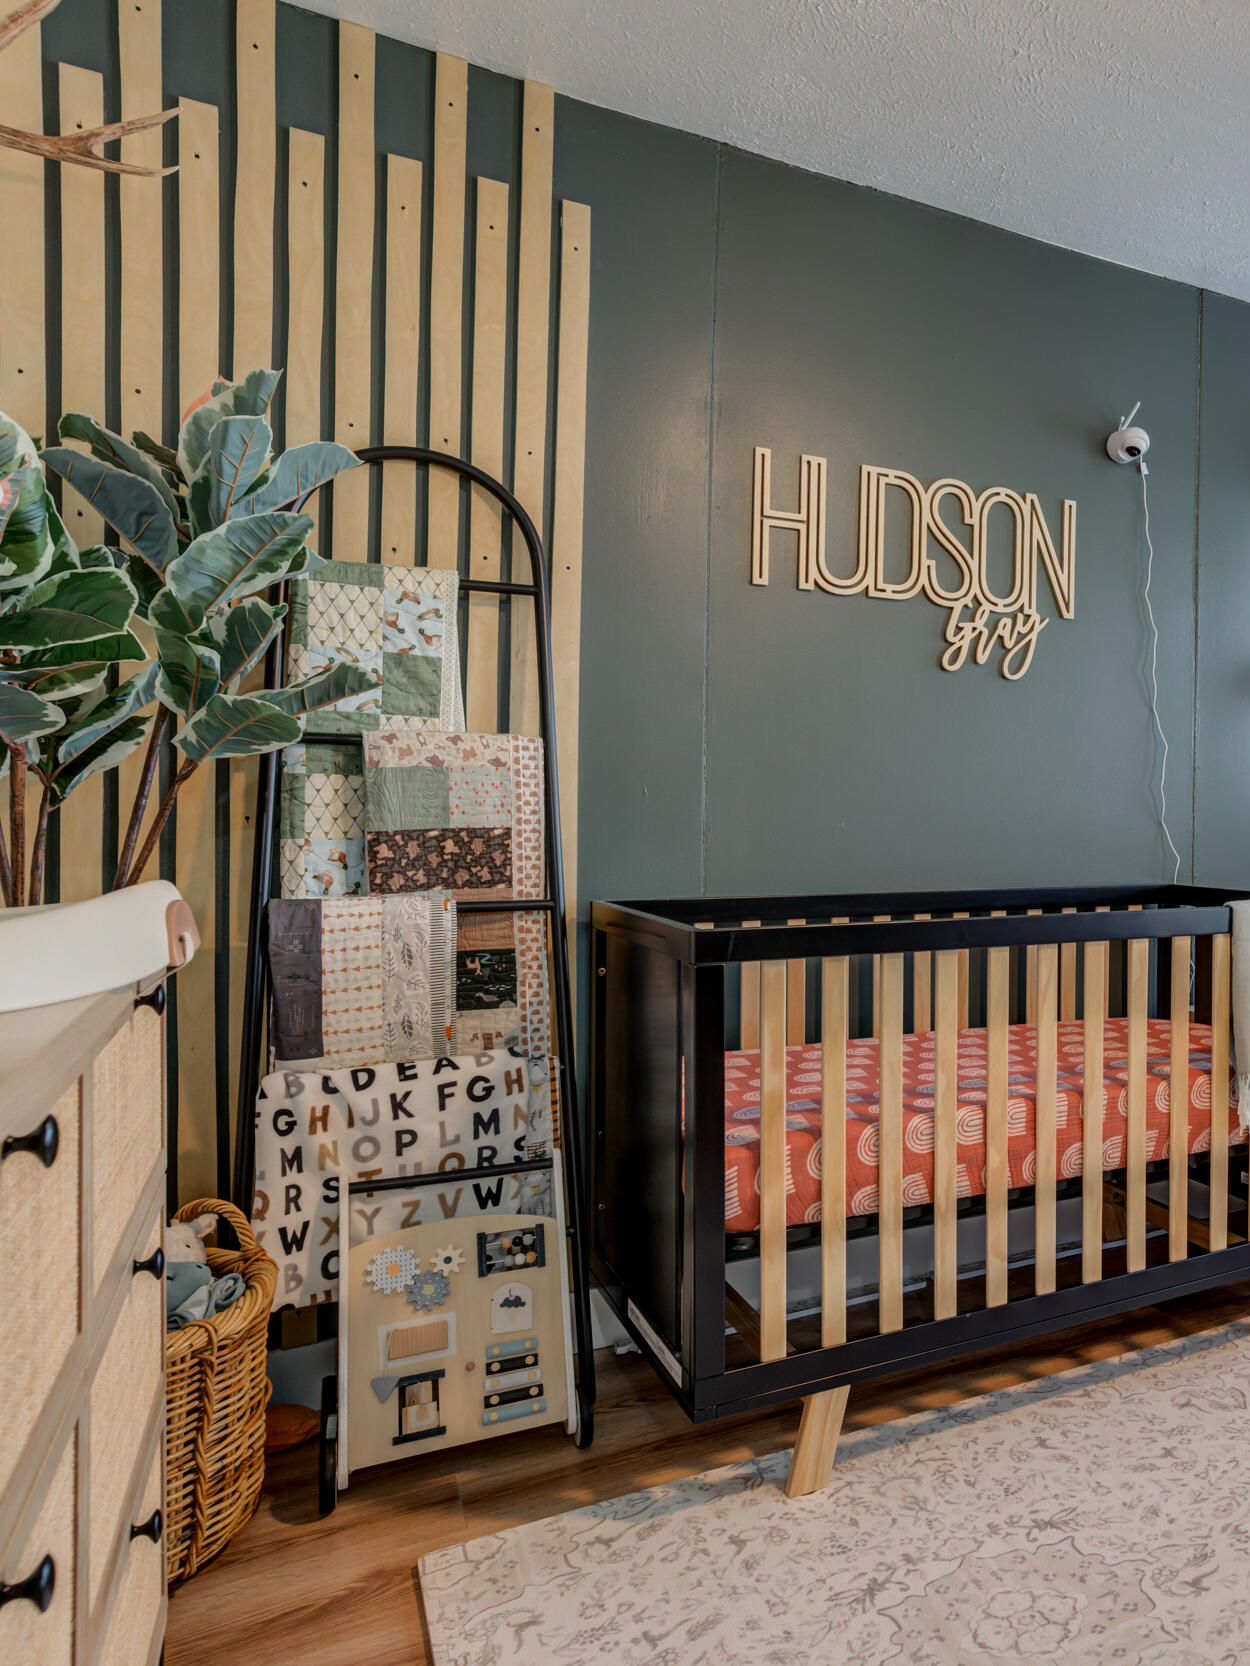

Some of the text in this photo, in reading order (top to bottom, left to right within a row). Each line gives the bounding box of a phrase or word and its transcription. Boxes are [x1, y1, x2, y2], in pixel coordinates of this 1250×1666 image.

[751, 446, 1077, 620] HUDSON
[941, 602, 1049, 681] Gray
[272, 1108, 297, 1137] G
[308, 1104, 331, 1136] H
[359, 1098, 380, 1127] J
[389, 1090, 415, 1121] K
[437, 1081, 458, 1112] F
[466, 1075, 495, 1102] G
[504, 1067, 524, 1096] H
[351, 1067, 376, 1091] D
[397, 1061, 418, 1082] E
[433, 1057, 460, 1075] A
[280, 1146, 303, 1177] M
[318, 1140, 341, 1171] N
[352, 1135, 381, 1163] O
[395, 1129, 418, 1157] P
[439, 1120, 461, 1149] L
[473, 1108, 501, 1140] M
[284, 1184, 302, 1215] R
[322, 1177, 340, 1204] S
[476, 1145, 498, 1169] R
[278, 1220, 310, 1256] W
[355, 1206, 383, 1236] Y
[401, 1199, 422, 1229] Z
[437, 1187, 463, 1219] V
[472, 1177, 504, 1210] W
[284, 1263, 303, 1295] B
